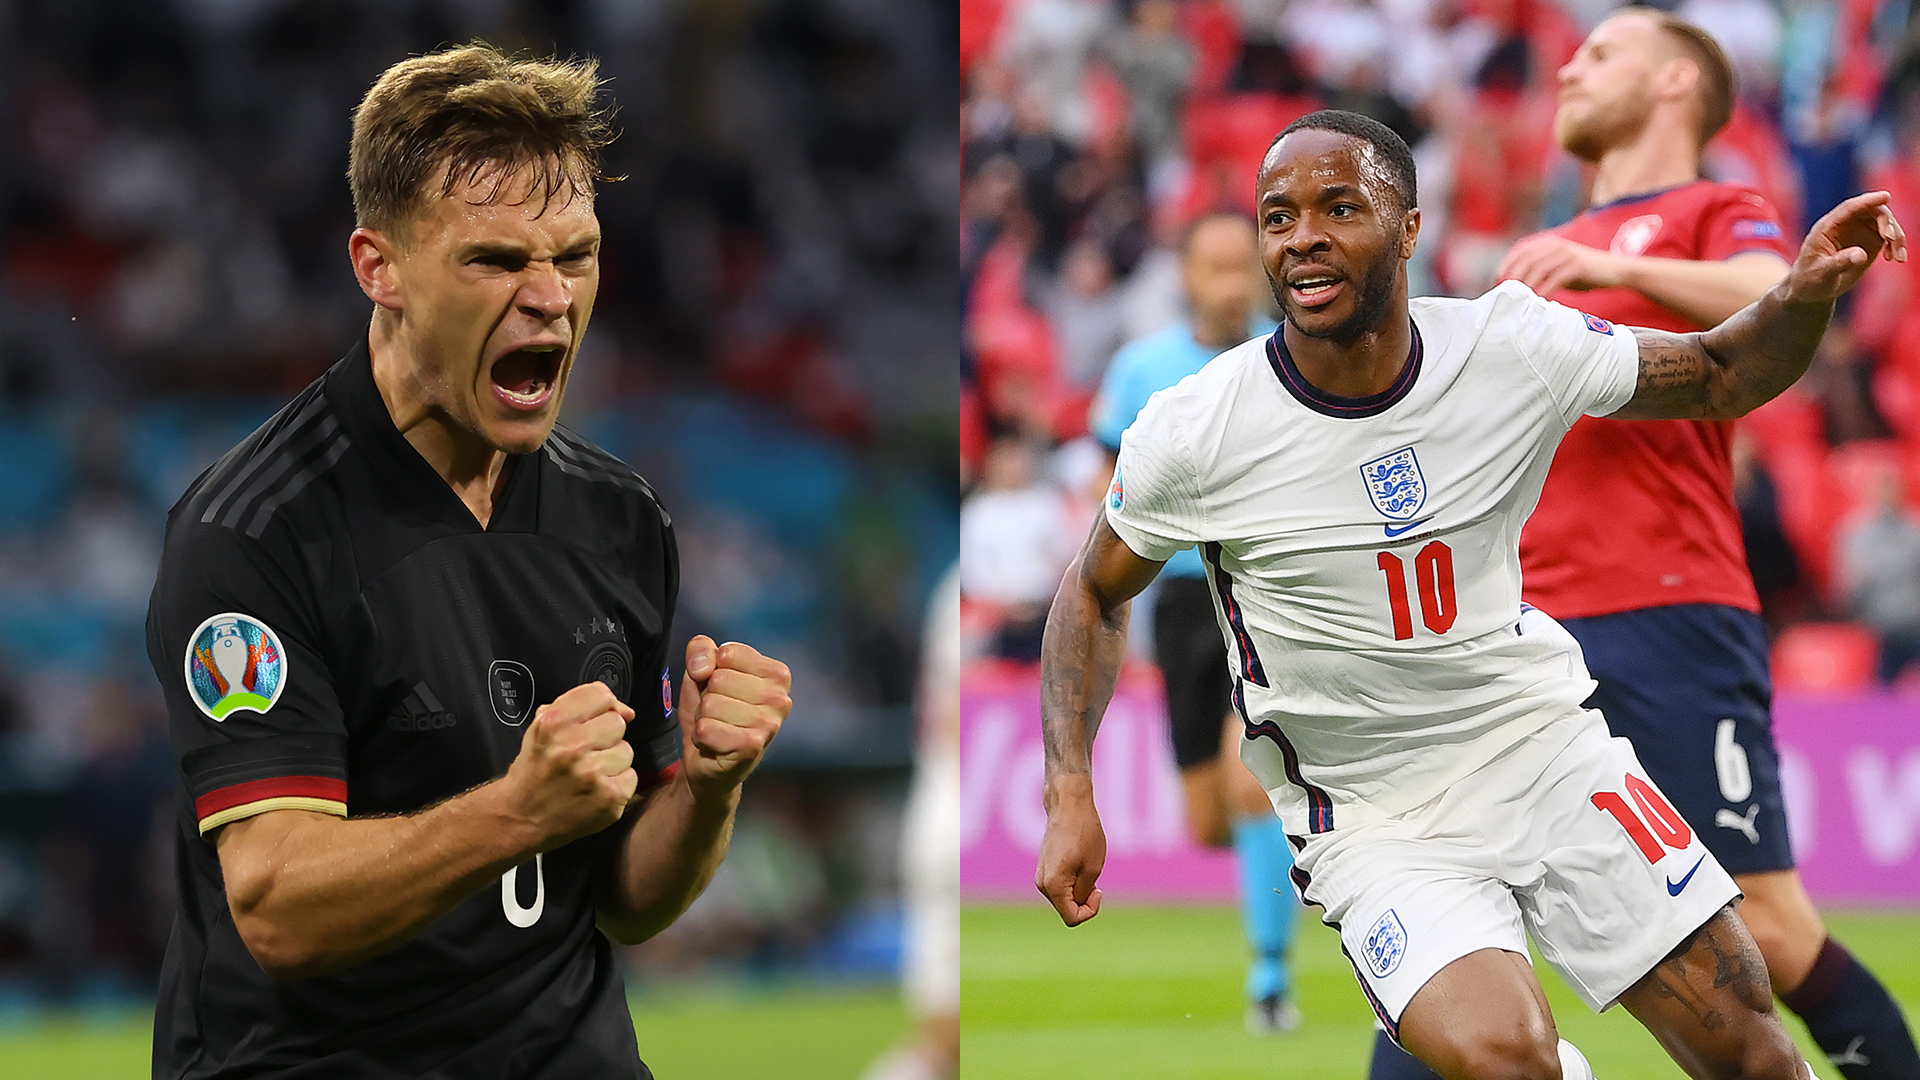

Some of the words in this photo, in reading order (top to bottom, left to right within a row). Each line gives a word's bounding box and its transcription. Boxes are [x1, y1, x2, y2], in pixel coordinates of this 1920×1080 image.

[1376, 540, 1458, 641] 10
[387, 712, 457, 732] adidas
[1714, 718, 1752, 804] 6
[1590, 772, 1692, 865] 10
